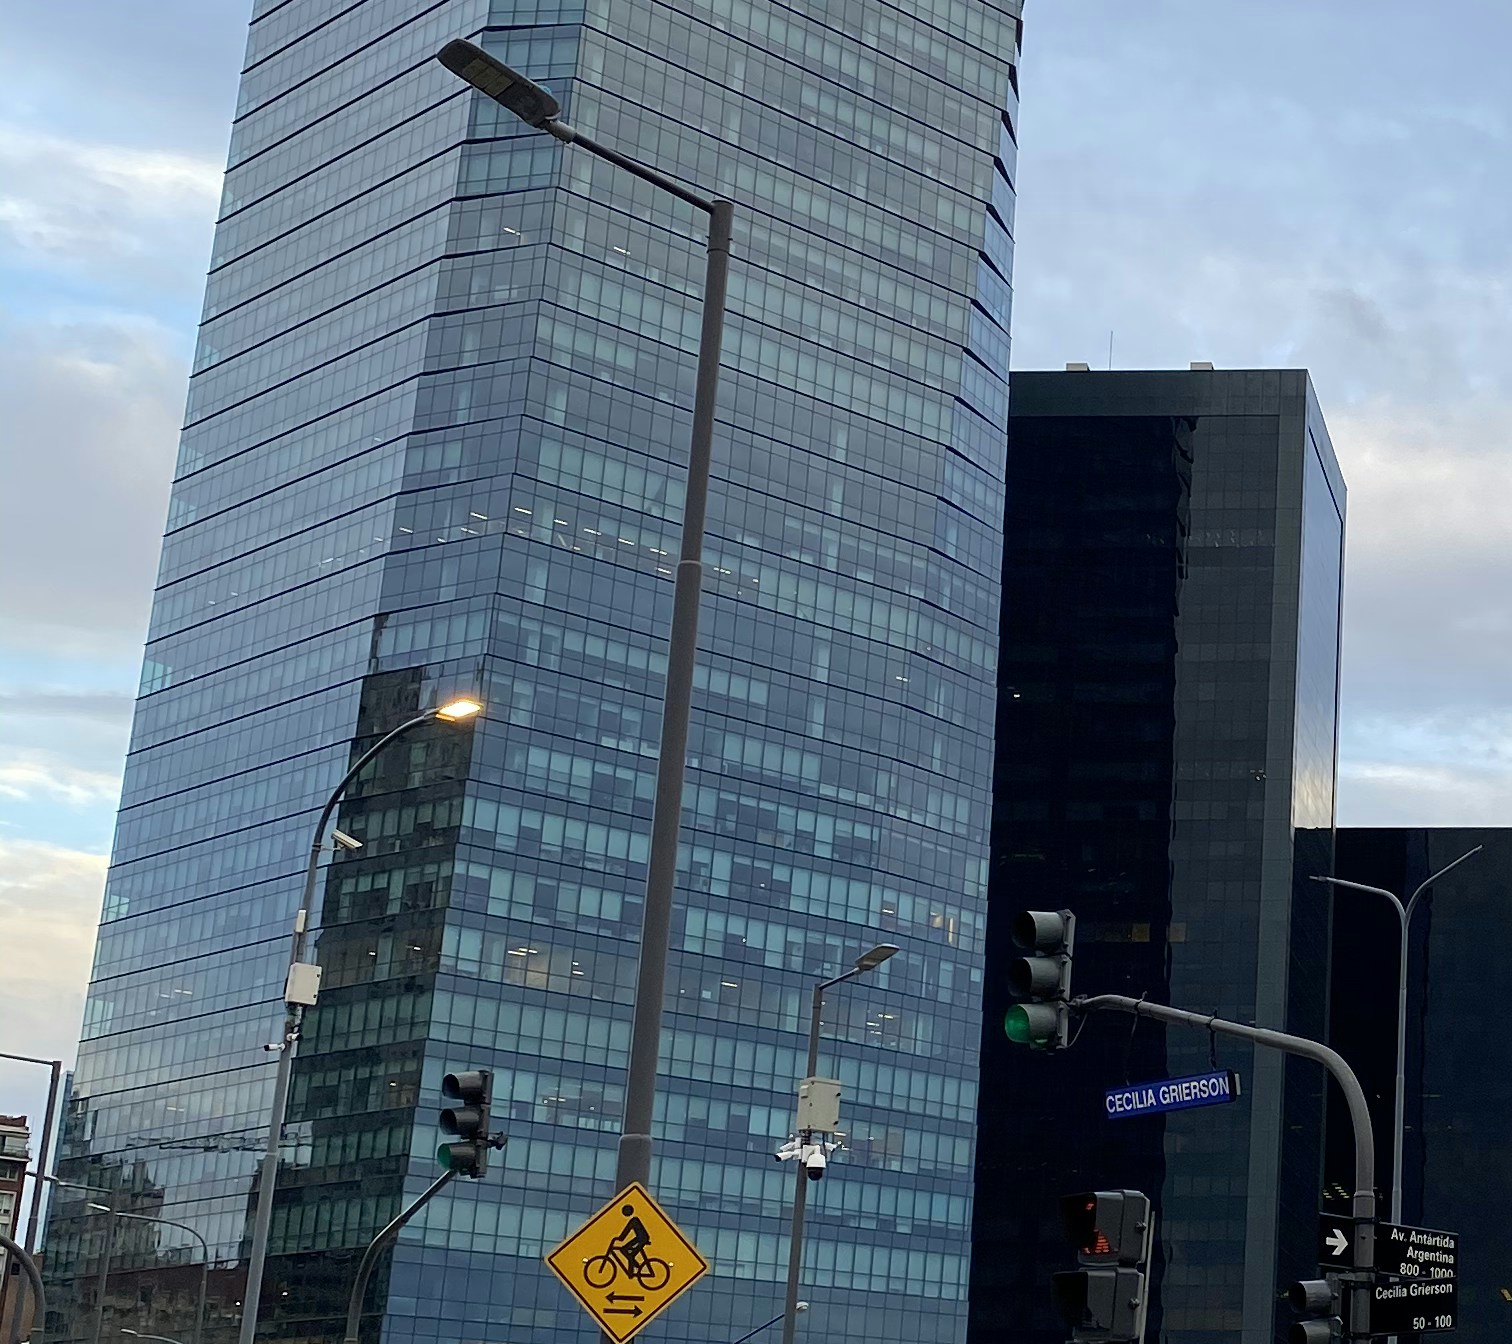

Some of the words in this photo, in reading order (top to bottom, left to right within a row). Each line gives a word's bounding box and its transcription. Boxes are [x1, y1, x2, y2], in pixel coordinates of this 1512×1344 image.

[1105, 1088, 1157, 1114] CECILIA
[1159, 1076, 1231, 1105] GRIERSON
[1390, 1227, 1408, 1243] Av.
[1409, 1230, 1455, 1249] Antártida
[1406, 1245, 1455, 1264] Argentina
[1399, 1262, 1420, 1277] 800
[1429, 1266, 1454, 1279] 1000
[1375, 1284, 1408, 1300] Cecilia
[1409, 1282, 1453, 1297] Grierson
[1412, 1316, 1426, 1330] 50
[1434, 1314, 1453, 1329] 100
